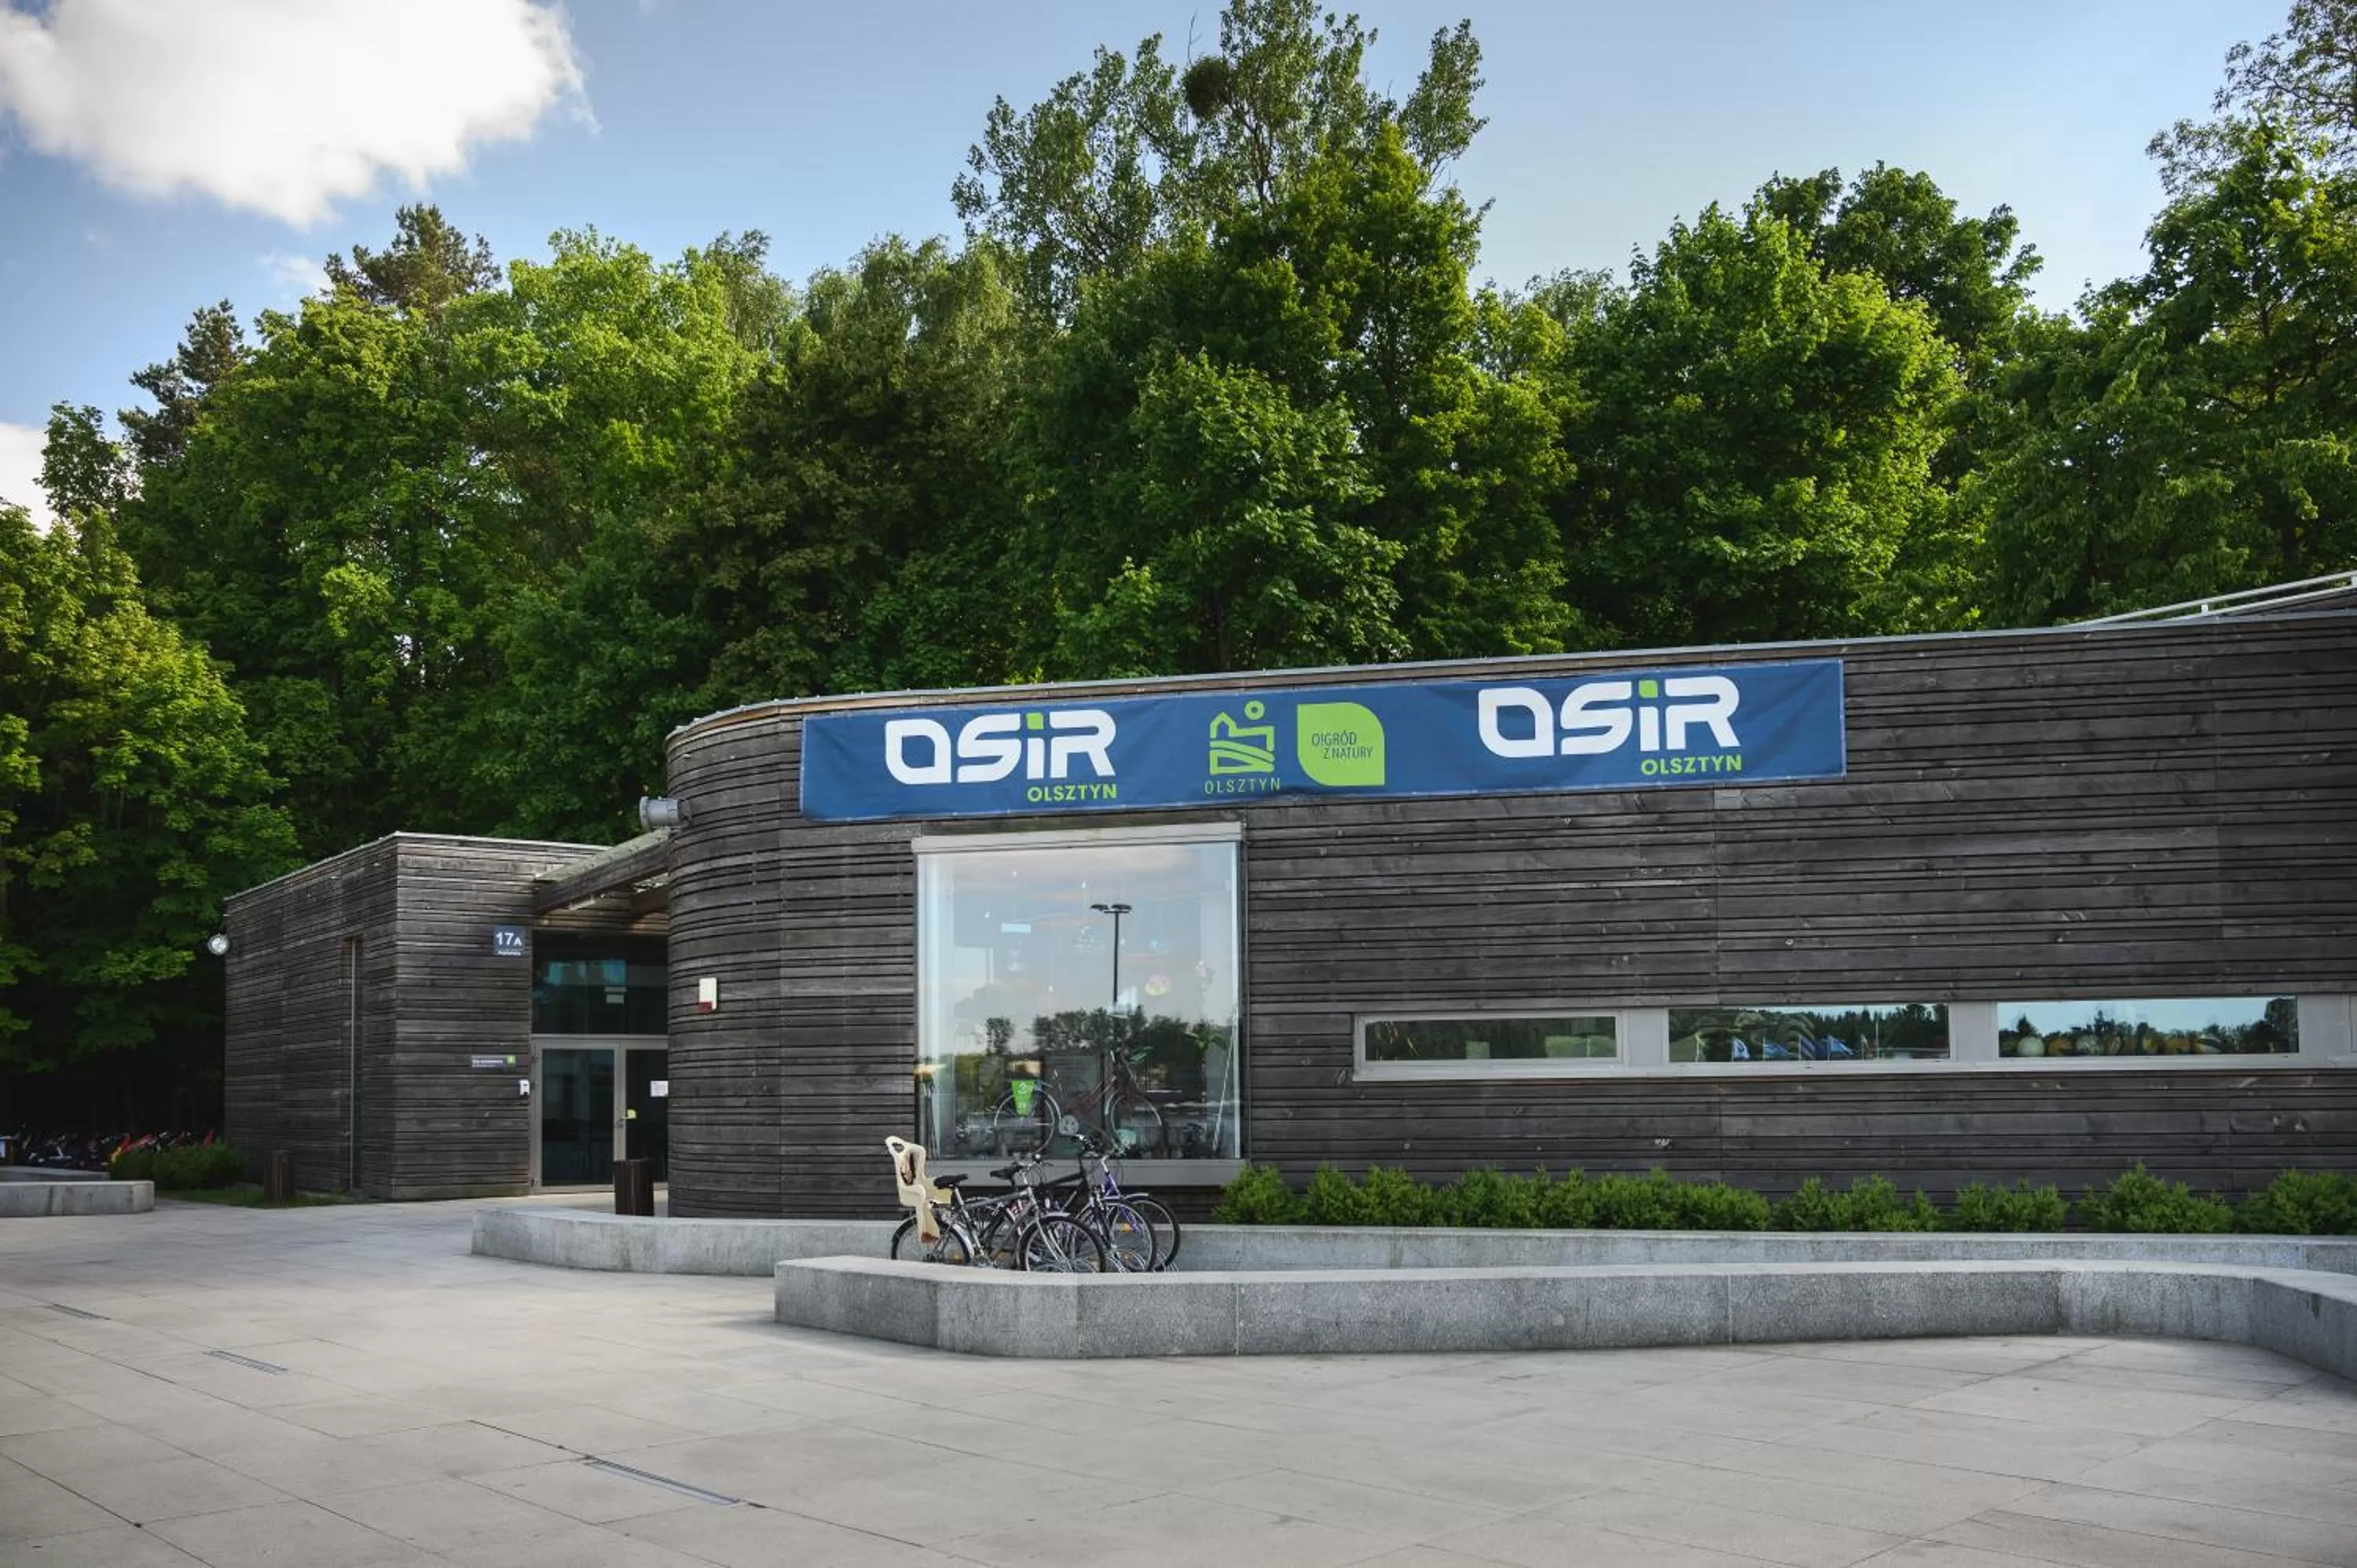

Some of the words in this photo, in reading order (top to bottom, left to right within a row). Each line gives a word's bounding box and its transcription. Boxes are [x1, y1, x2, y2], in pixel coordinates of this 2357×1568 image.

[1323, 747, 1331, 760] Z
[1332, 746, 1373, 760] NATURY
[1640, 754, 1742, 775] OLSZTYN
[1027, 783, 1118, 802] OLSZTYN
[1204, 777, 1281, 794] OLSZTYN
[496, 932, 522, 947] 17A
